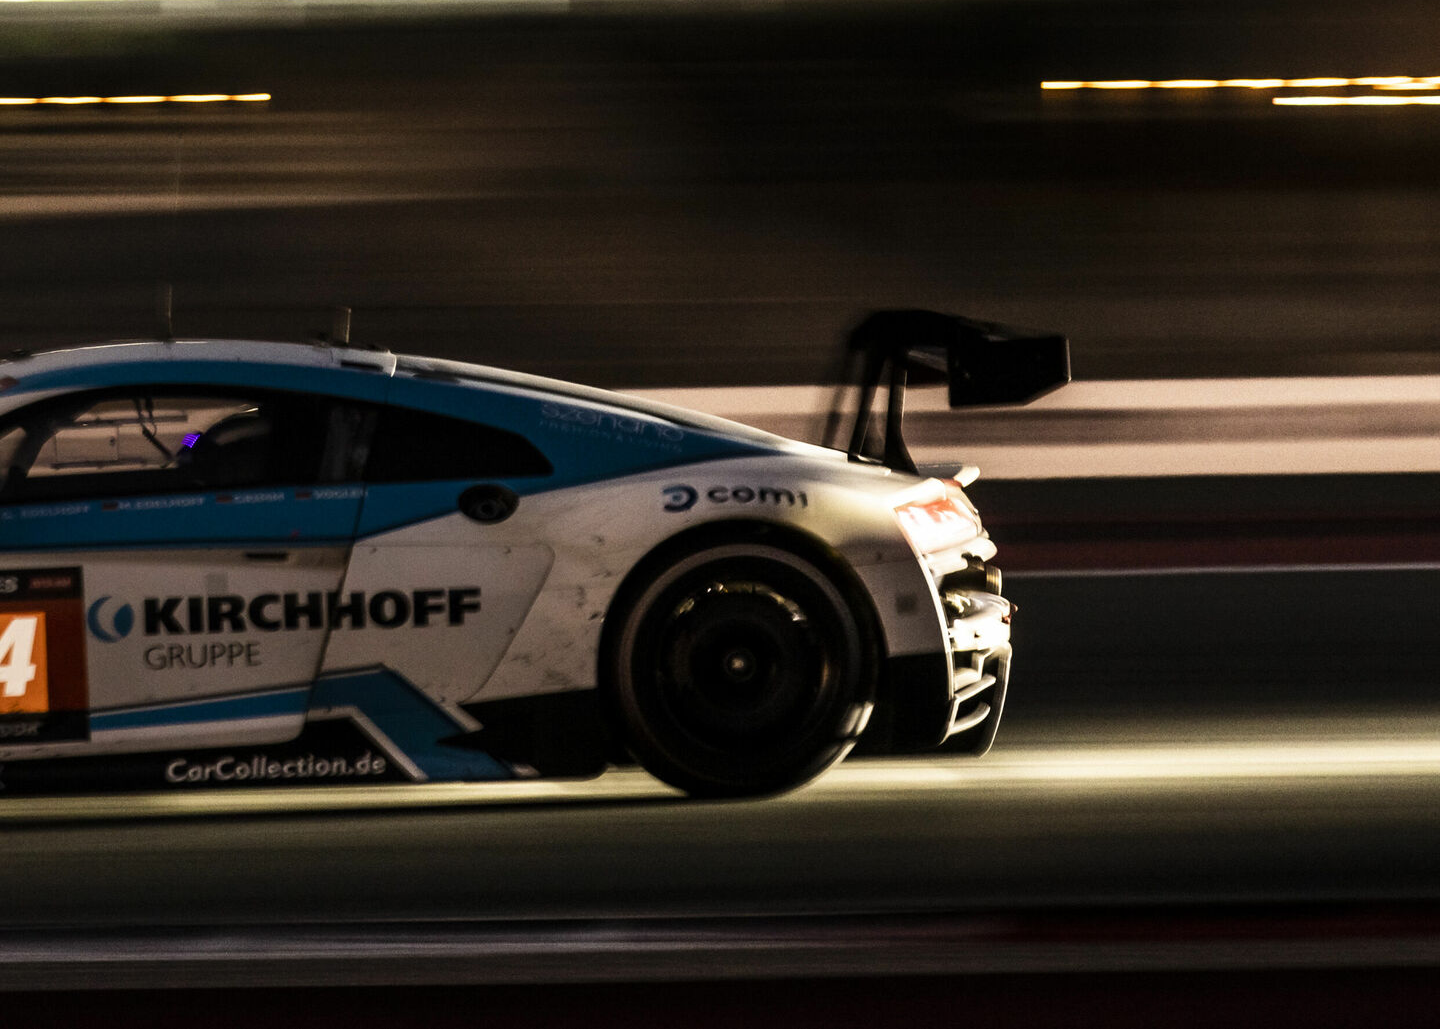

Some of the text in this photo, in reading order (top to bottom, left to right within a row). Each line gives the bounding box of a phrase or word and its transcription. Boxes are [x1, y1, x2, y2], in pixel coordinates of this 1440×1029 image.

[143, 585, 481, 636] KIRCHHOFF
[144, 641, 262, 670] GRUPPE
[164, 749, 388, 783] CarCollection.de
